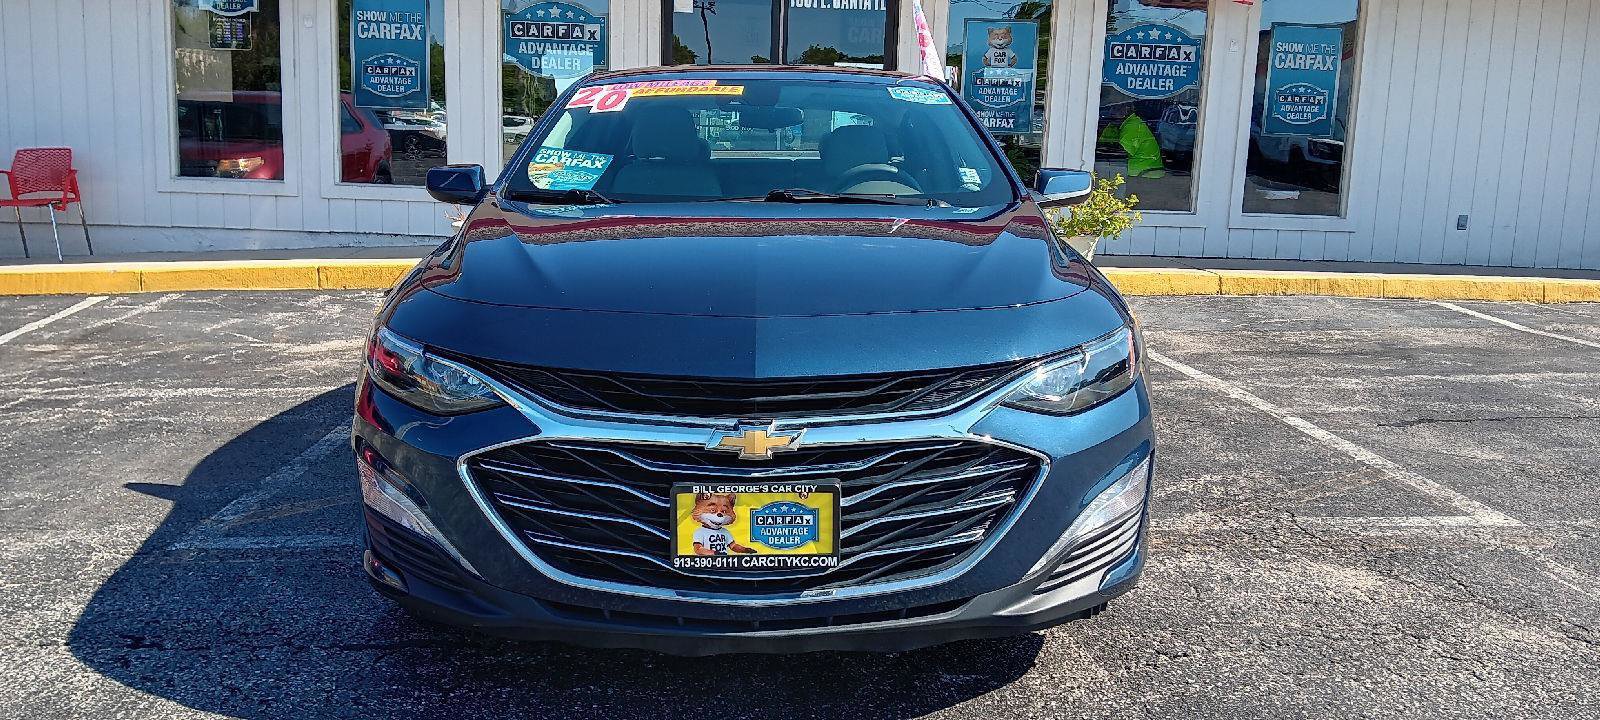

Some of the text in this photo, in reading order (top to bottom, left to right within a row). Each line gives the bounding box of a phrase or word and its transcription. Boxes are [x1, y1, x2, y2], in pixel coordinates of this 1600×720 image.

[357, 11, 422, 23] SHOW ME THE
[358, 23, 422, 40] CARFAX
[512, 22, 599, 40] CARFAX
[519, 42, 594, 56] ADVANTAGE
[1111, 44, 1196, 62] CARFAX
[1276, 42, 1336, 55] SHOW ME THE
[532, 57, 580, 70] DEALER
[1275, 53, 1335, 70] CARFAX
[366, 66, 415, 76] CARFAX
[1116, 63, 1187, 77] ADVANTAGE
[370, 77, 412, 85] ADVANTAGE
[976, 78, 1021, 86] CARFAX
[1128, 78, 1174, 90] DEALER
[377, 85, 404, 93] DEALER
[633, 86, 739, 95] AFFORDABLE
[569, 87, 627, 110] 20
[1279, 95, 1324, 104] CARFAX
[1280, 105, 1319, 113] ADVANTAGE
[540, 148, 572, 158] SHOW
[535, 154, 605, 168] CARFAX
[795, 485, 817, 493] CITY
[756, 515, 813, 525] CARFAX
[709, 535, 726, 543] CAR
[674, 556, 838, 568] 913-390-0111 CARCITYKC.COM
